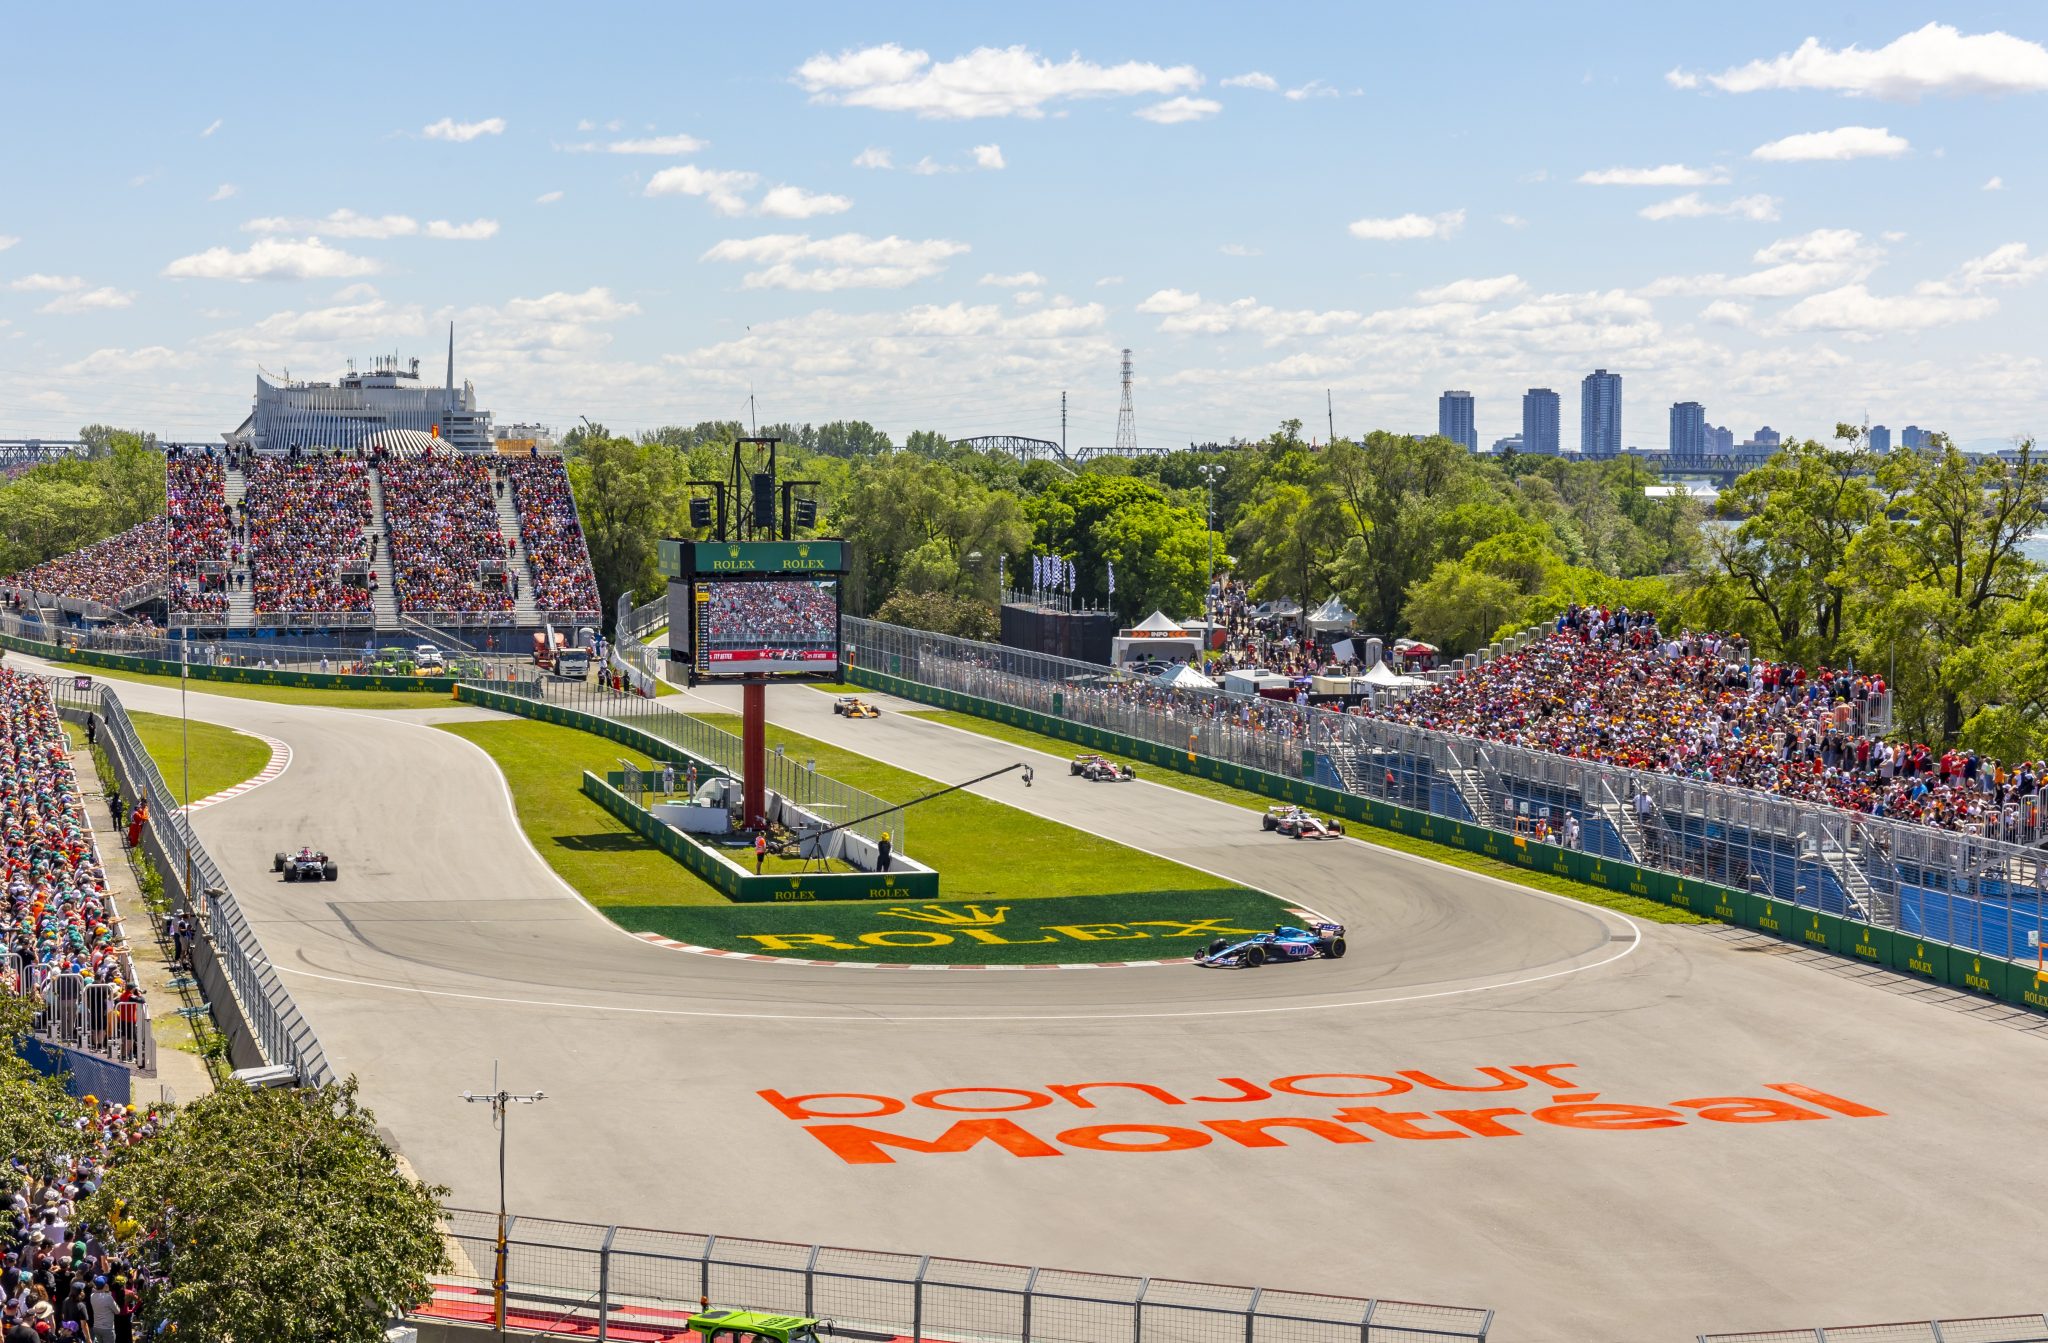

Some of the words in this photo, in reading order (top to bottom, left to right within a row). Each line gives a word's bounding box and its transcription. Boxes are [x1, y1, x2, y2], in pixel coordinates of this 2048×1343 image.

[713, 560, 755, 569] ROLEX
[783, 560, 824, 568] ROLEX
[1518, 854, 1532, 864] ROLEX
[1554, 862, 1568, 873] ROLEX
[1590, 872, 1606, 883] ROLEX
[870, 889, 910, 897] ROLEX
[1630, 882, 1648, 894] ROLEX
[775, 891, 816, 900] ROLEX
[1672, 894, 1689, 906] ROLEX
[1715, 905, 1733, 917] ROLEX
[1760, 917, 1779, 930] ROLEX
[738, 919, 1273, 950] ROLEX
[1805, 930, 1825, 944] ROLEX
[1290, 945, 1309, 955] BWT
[1855, 944, 1877, 958] ROLEX
[1909, 958, 1933, 974] ROLEX
[1965, 974, 1990, 990] ROLEX
[2024, 990, 2048, 1006] ROLEX
[756, 1063, 1578, 1120] bonjour
[802, 1083, 1888, 1164] Montréal
